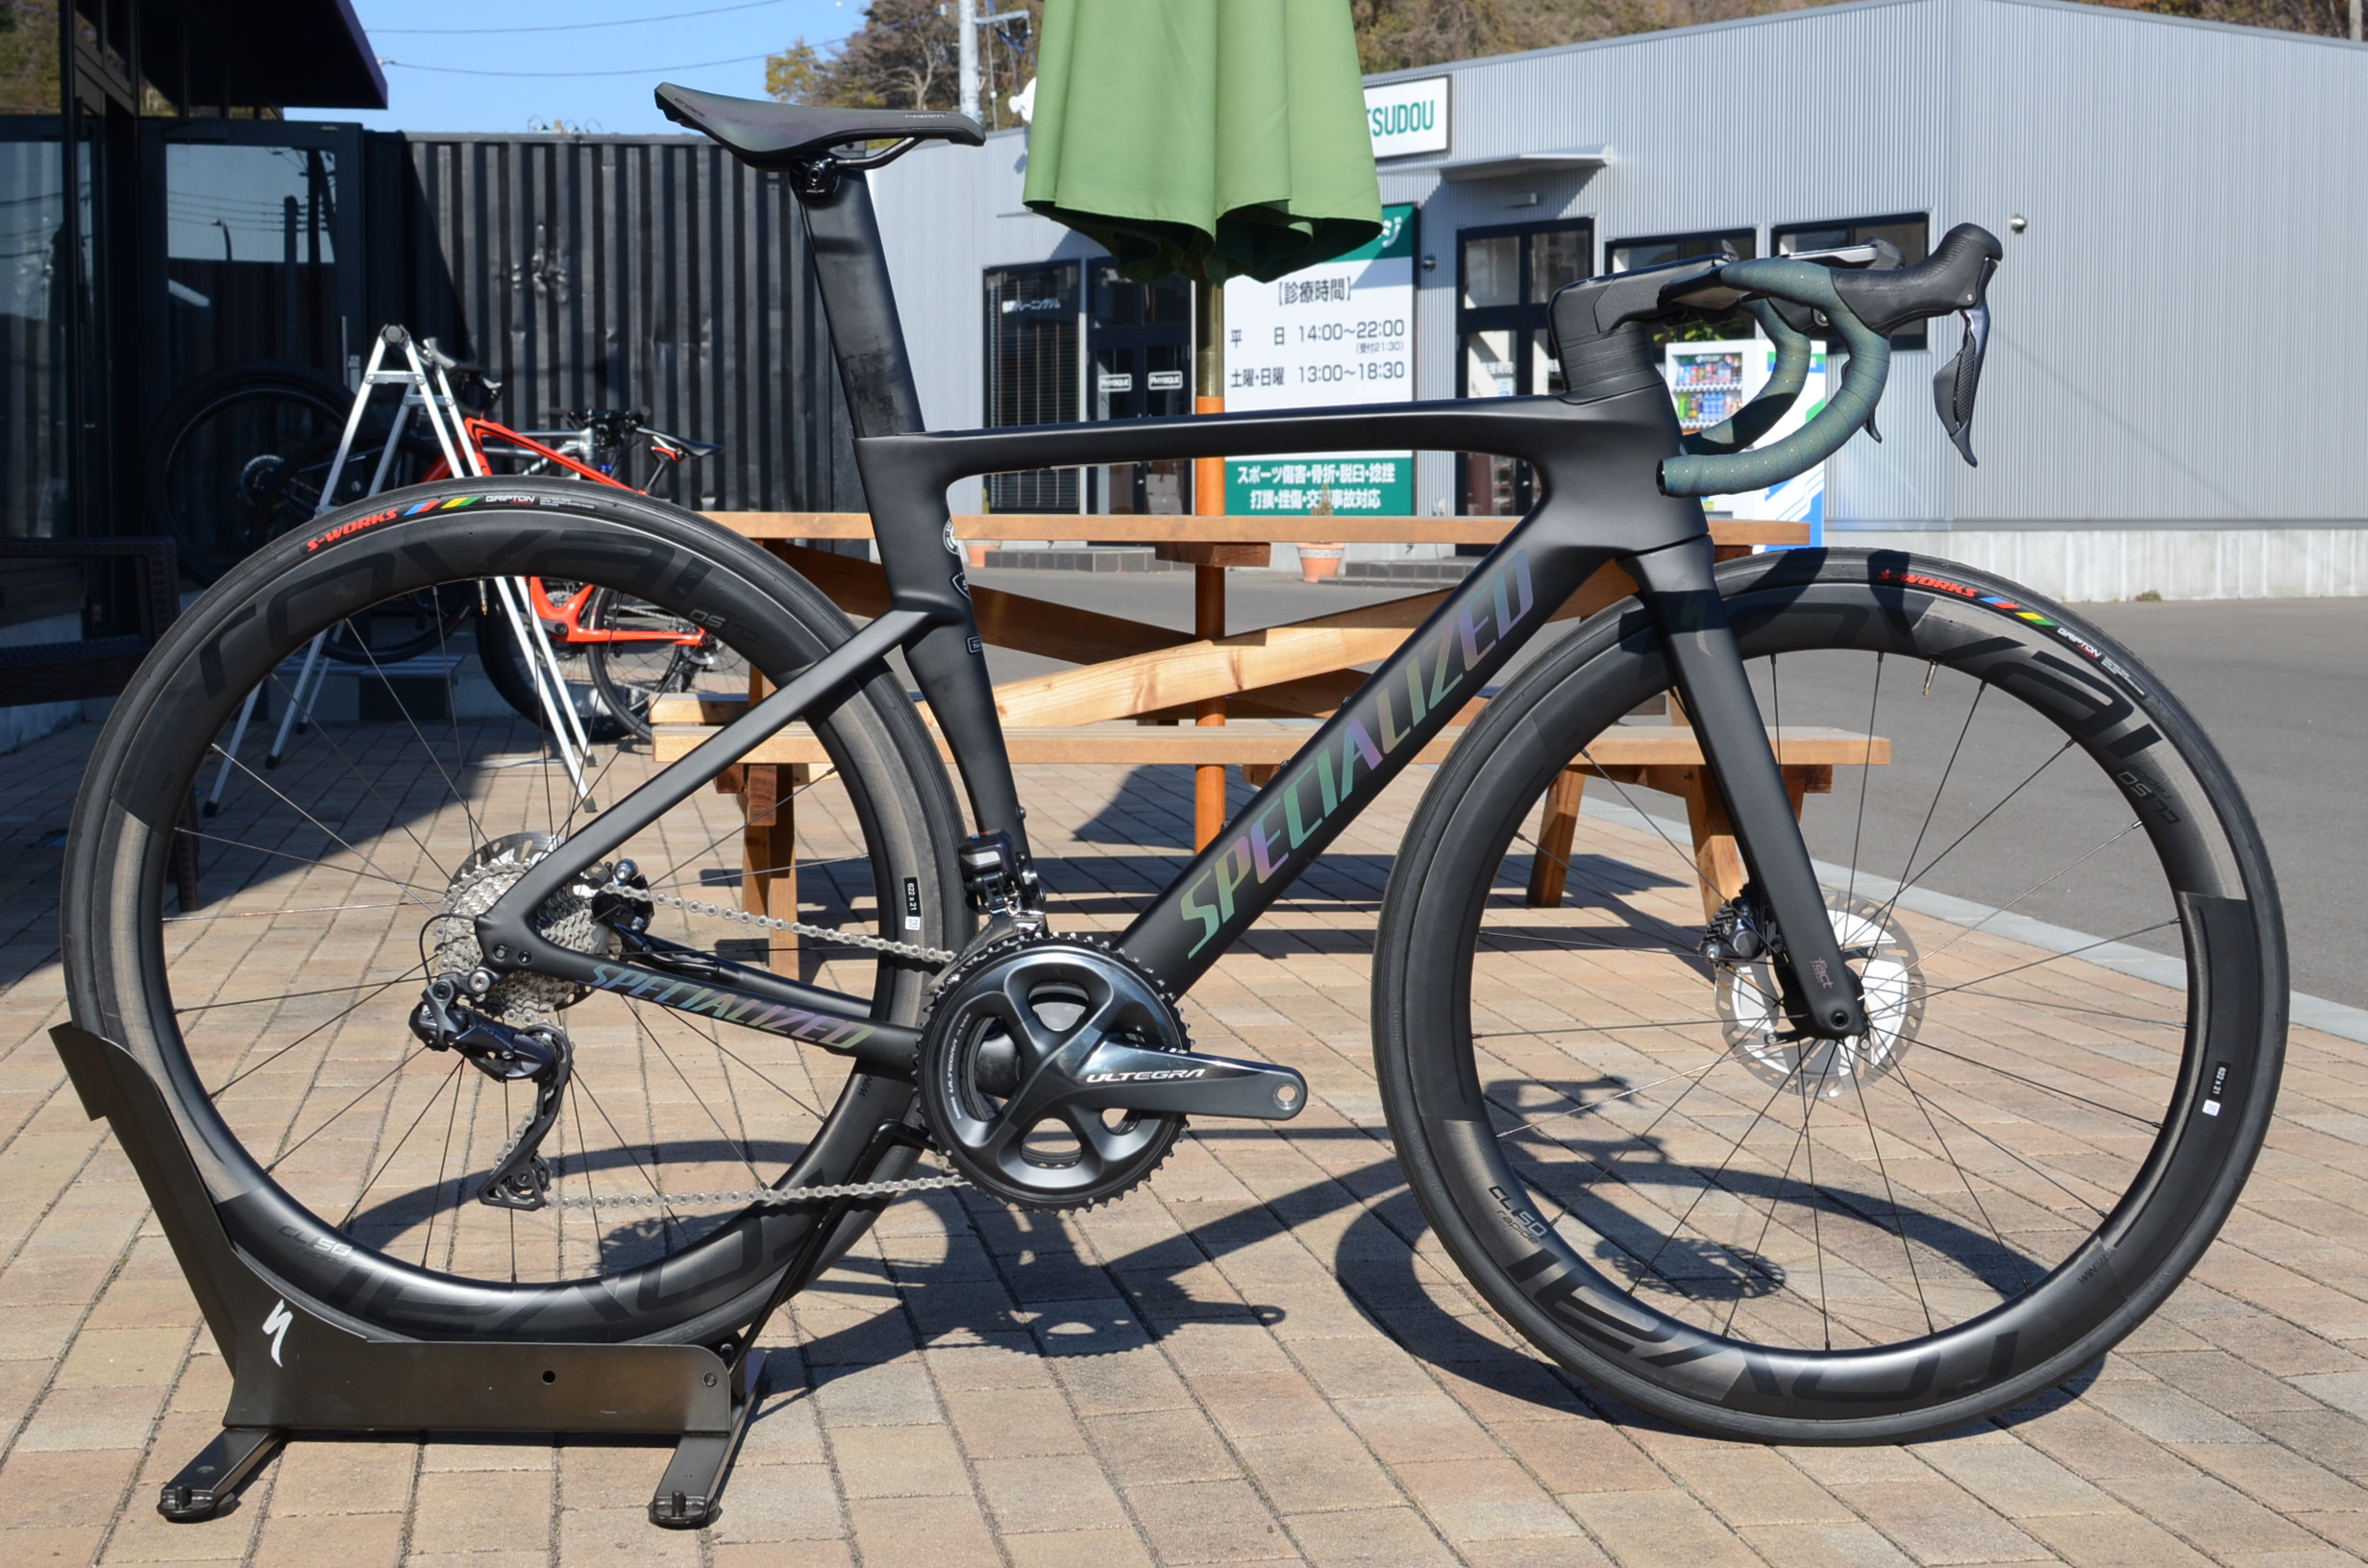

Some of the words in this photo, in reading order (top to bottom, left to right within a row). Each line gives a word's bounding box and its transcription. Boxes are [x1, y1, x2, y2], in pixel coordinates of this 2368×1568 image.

[1366, 99, 1435, 137] SUDOU
[485, 495, 536, 503] GRIPTON
[1250, 488, 1382, 510] 打撲・挫傷・交事故対応
[306, 508, 399, 552] S-WORKS
[1880, 568, 1981, 598] S-WORKS
[2057, 627, 2103, 658] GRIPTON
[1180, 548, 1534, 959] SPECIALIZED
[591, 963, 877, 1049] SPECIALIZED
[1086, 1068, 1206, 1084] ULTEGRA
[1488, 1185, 1512, 1211] CL
[1515, 1211, 1547, 1237] 50
[1496, 1210, 1539, 1245] rapide
[313, 1237, 354, 1257] 50
